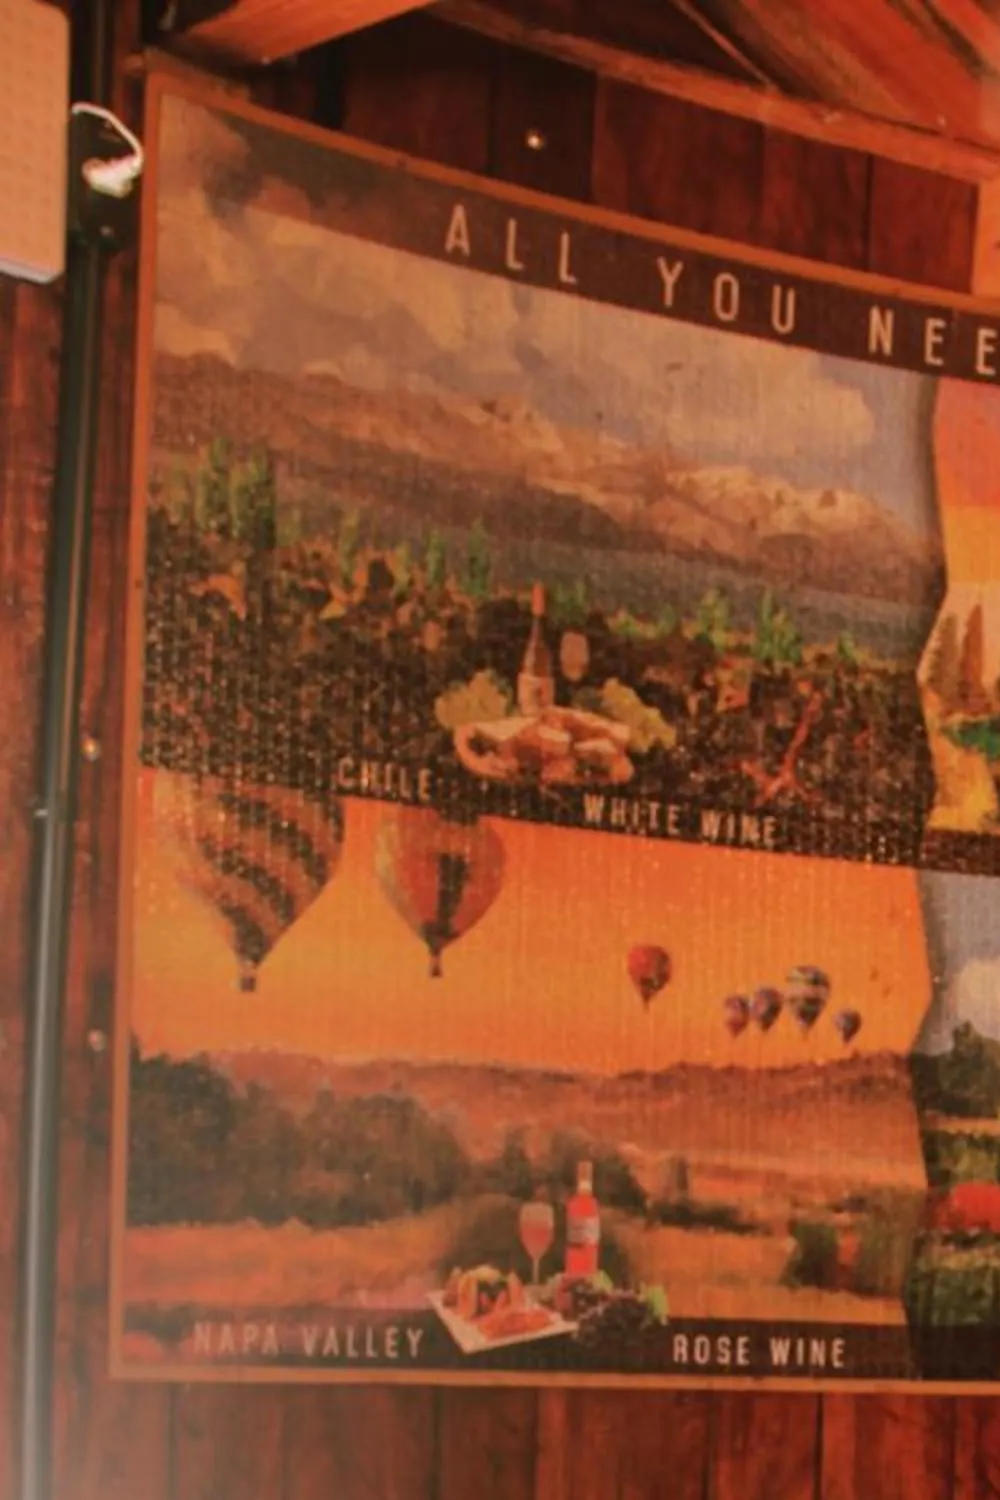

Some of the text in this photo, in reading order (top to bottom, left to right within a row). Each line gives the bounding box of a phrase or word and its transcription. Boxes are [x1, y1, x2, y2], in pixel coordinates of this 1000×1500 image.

[445, 204, 577, 284] ALL
[657, 255, 797, 334] YOU
[338, 756, 432, 802] CHILE
[584, 792, 776, 850] WHITE WINE
[195, 1320, 424, 1359] NAPA VALLEY
[673, 1333, 846, 1368] ROSE WINE
